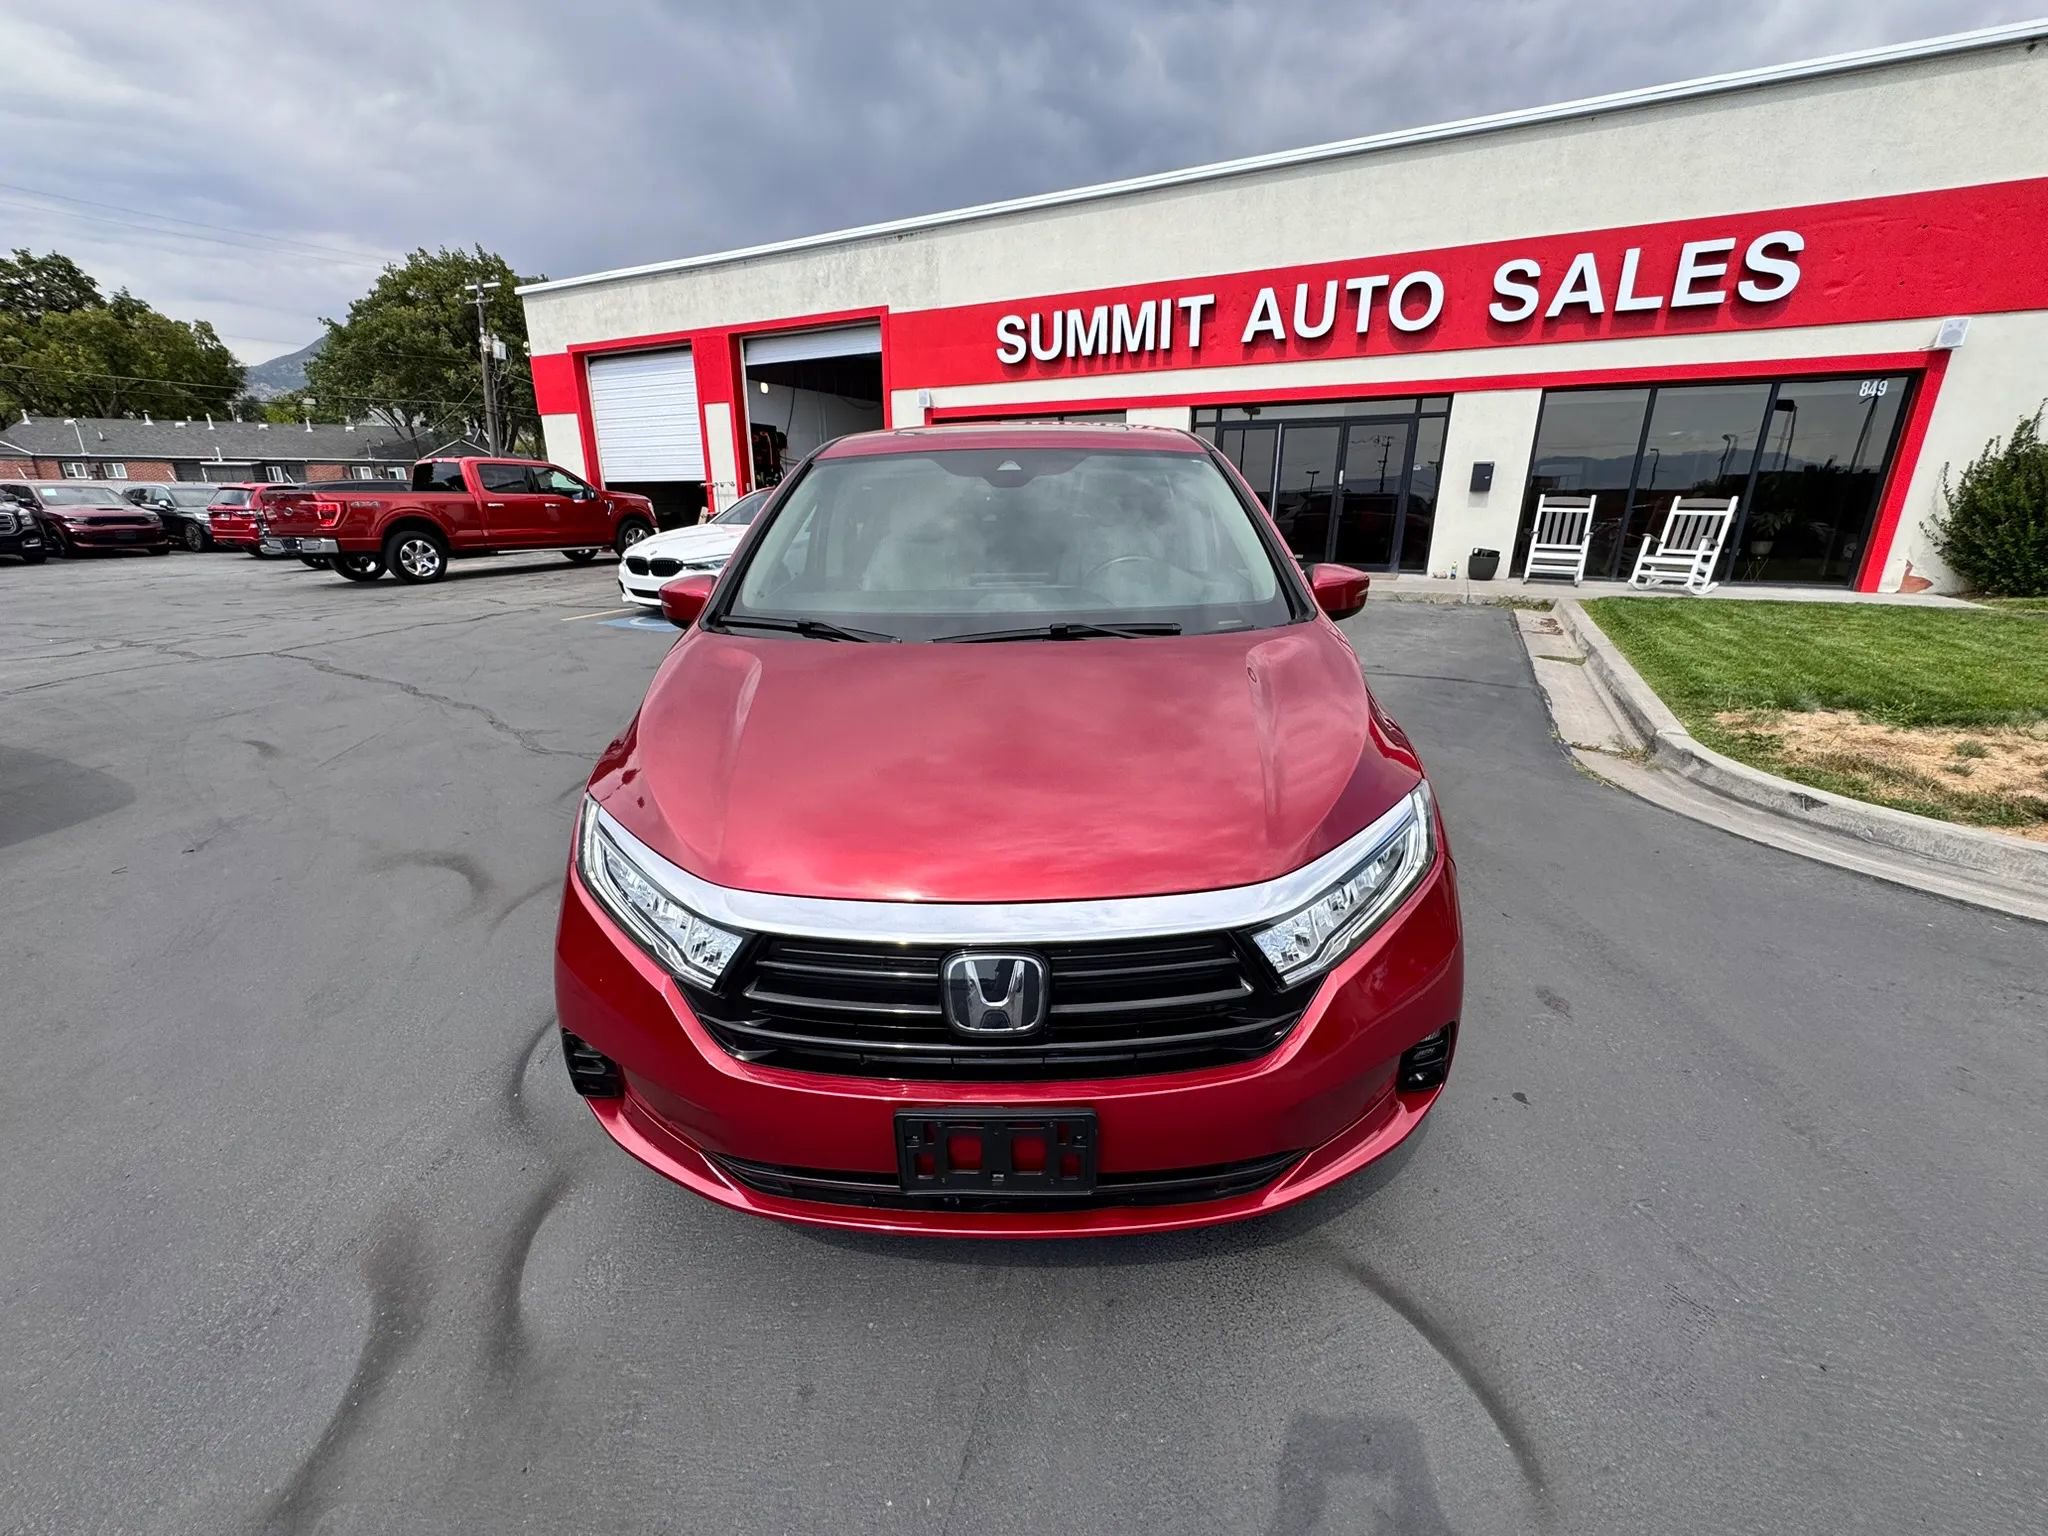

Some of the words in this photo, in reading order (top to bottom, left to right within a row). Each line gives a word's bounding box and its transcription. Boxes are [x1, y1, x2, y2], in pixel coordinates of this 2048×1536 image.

[995, 293, 1215, 365] SUMMIT
[1241, 270, 1445, 343] AUTO
[1489, 230, 1806, 323] SALES
[1859, 380, 1888, 396] 849
